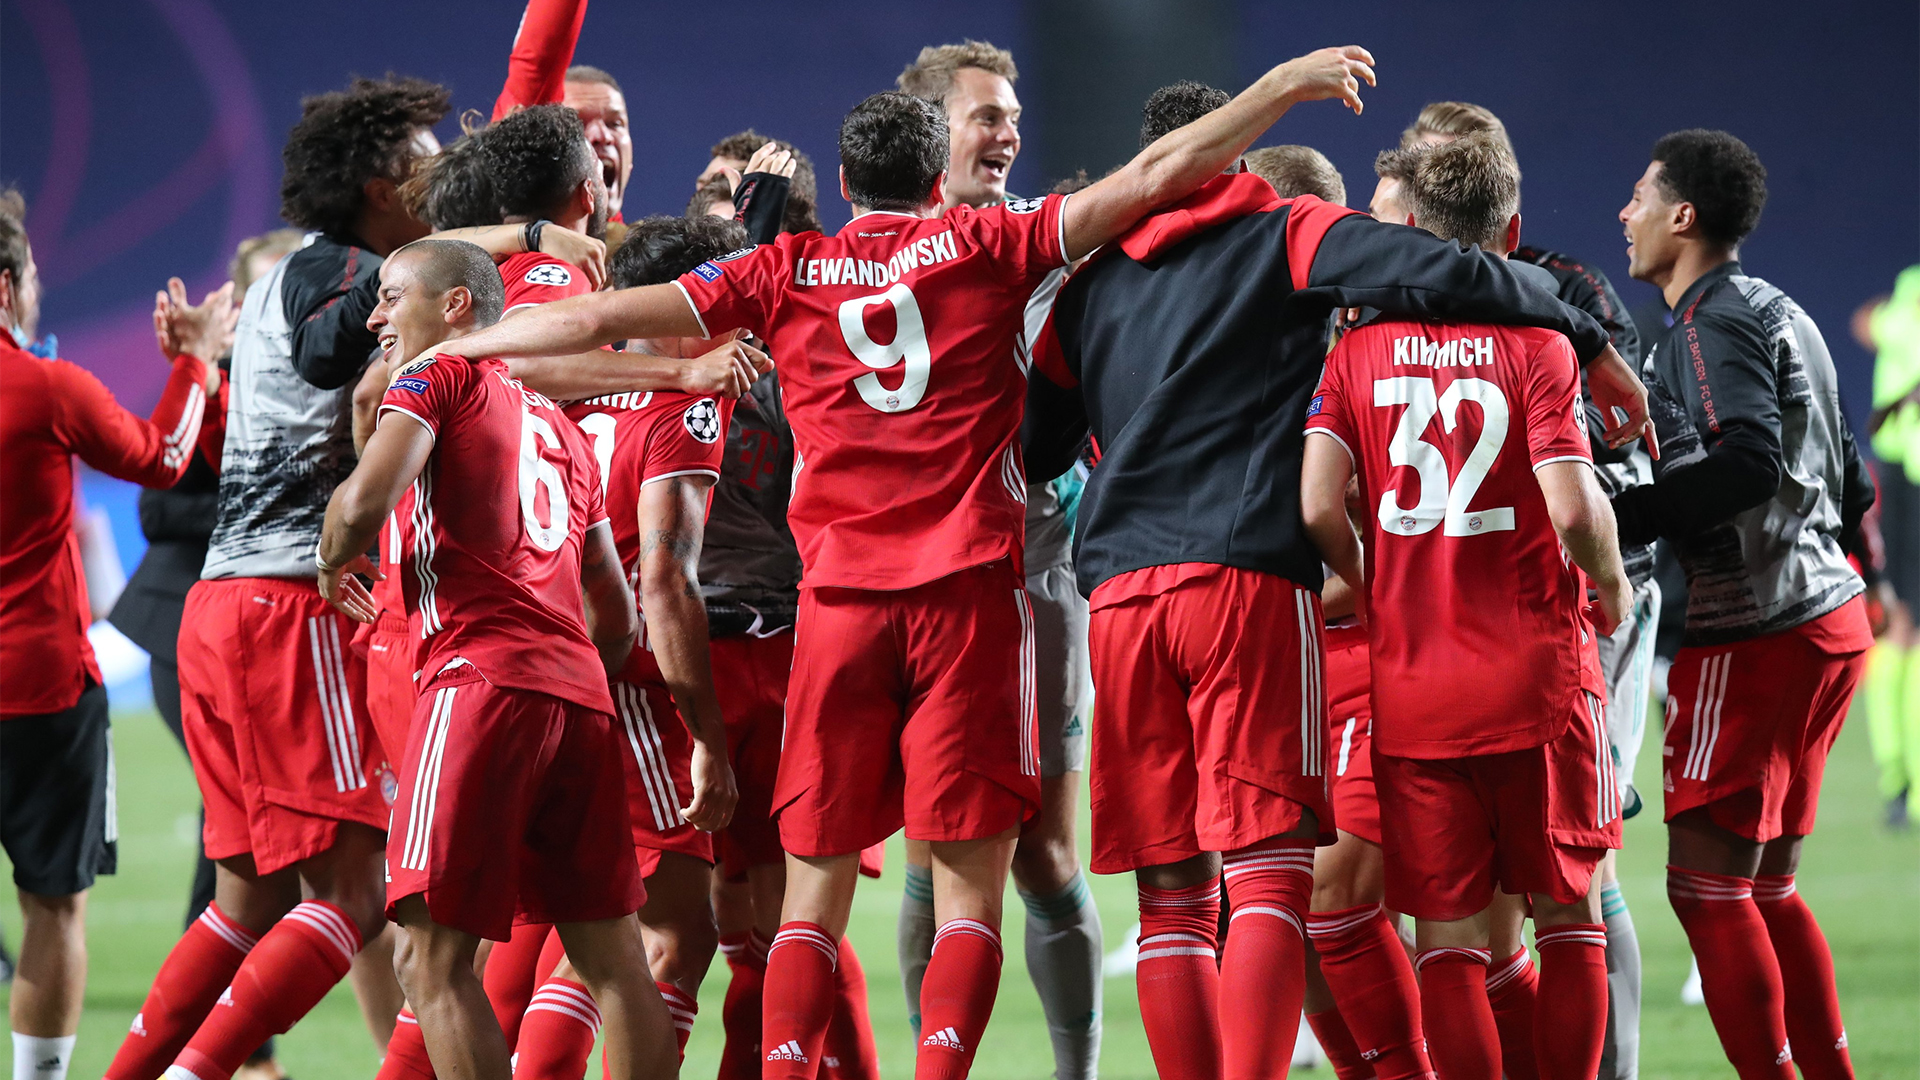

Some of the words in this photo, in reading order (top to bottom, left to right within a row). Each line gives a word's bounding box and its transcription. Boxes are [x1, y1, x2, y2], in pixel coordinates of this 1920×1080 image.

[794, 229, 958, 288] LEWANDOWSKI
[838, 282, 931, 413] 9
[1685, 327, 1698, 342] FC
[1689, 341, 1707, 382] BAYERN
[1699, 384, 1711, 400] FC
[1373, 375, 1516, 537] 32
[518, 403, 570, 552] 6
[767, 1052, 809, 1064] adidas
[923, 1037, 965, 1052] adidas
